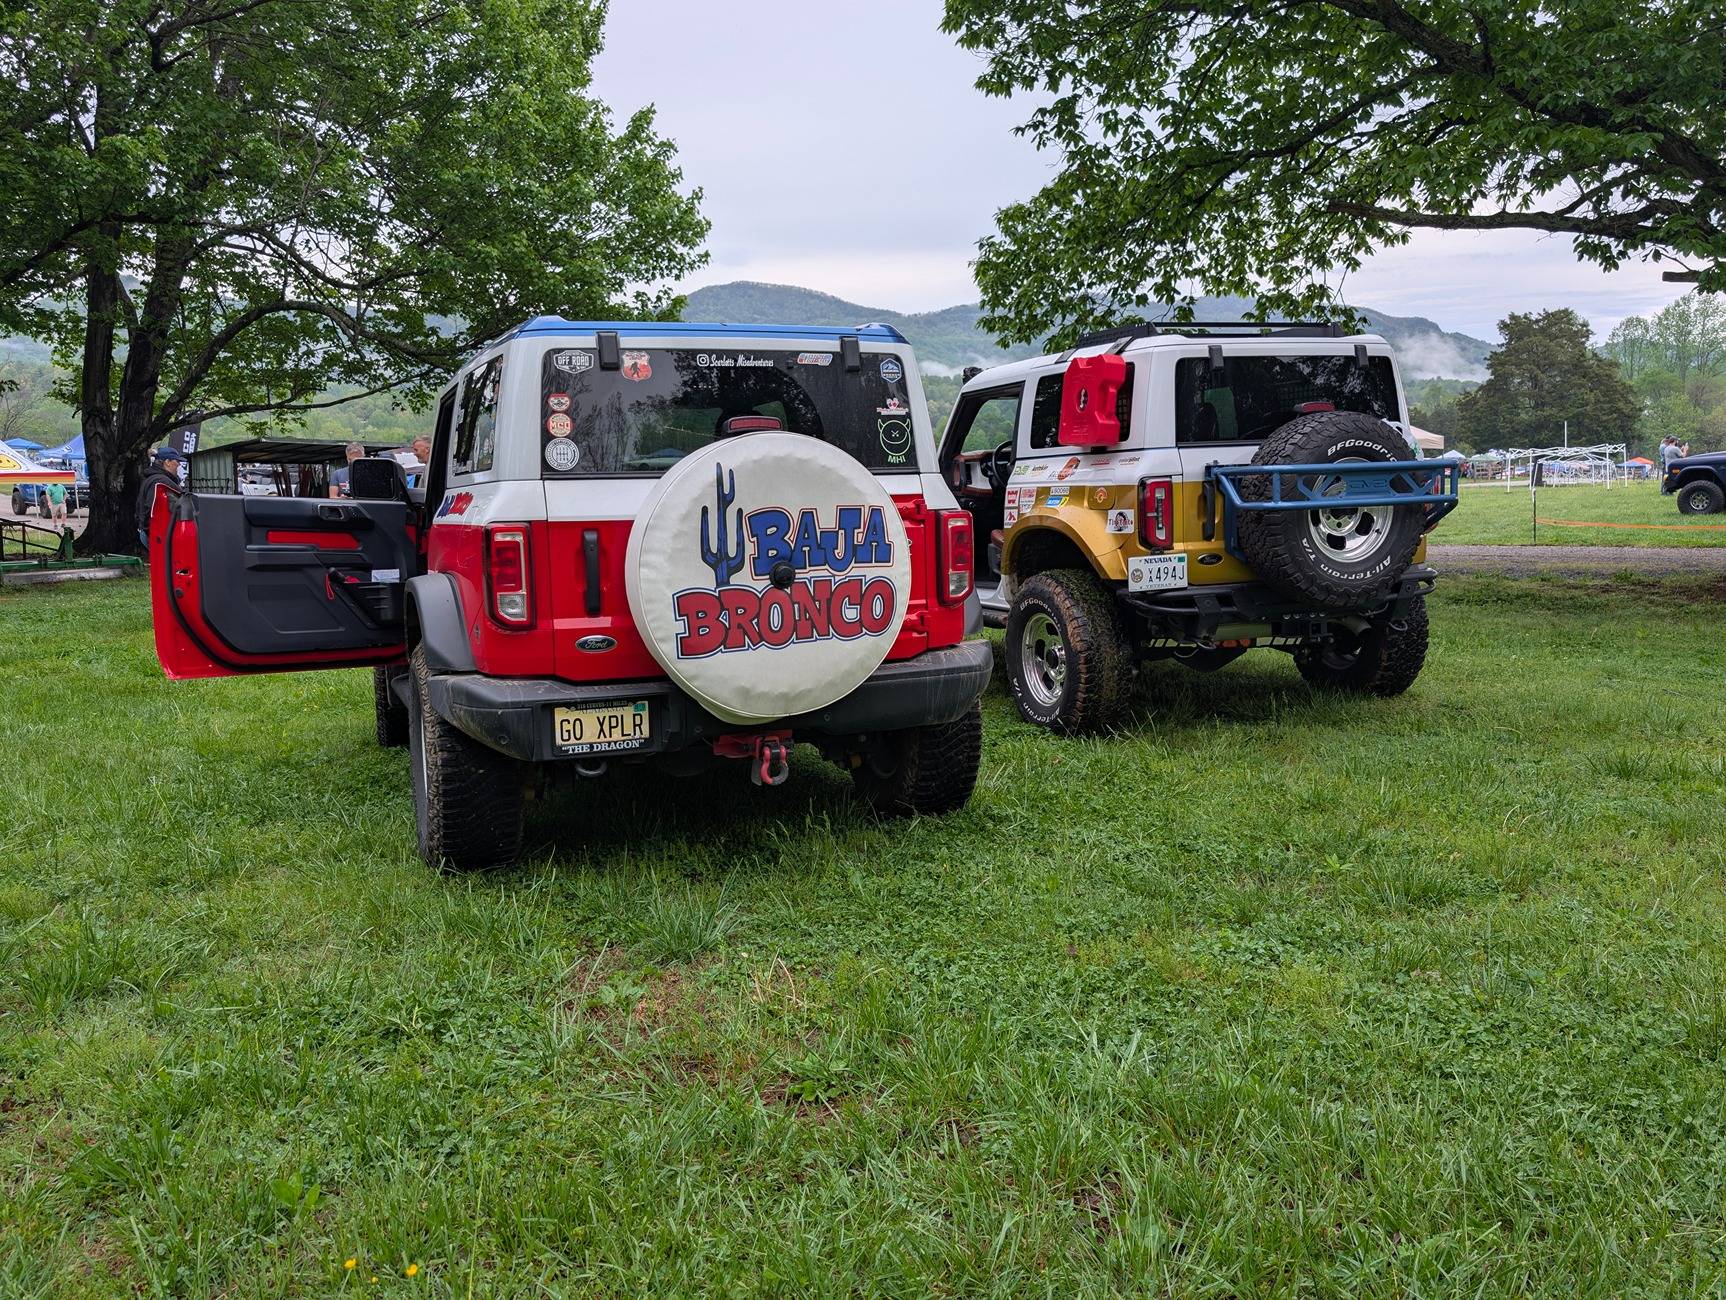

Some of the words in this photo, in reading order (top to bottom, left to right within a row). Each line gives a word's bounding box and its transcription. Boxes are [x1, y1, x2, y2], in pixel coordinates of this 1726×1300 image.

[557, 356, 569, 366] OFF
[571, 355, 590, 366] ROAD
[736, 354, 774, 367] Misadventures
[887, 455, 906, 464] MHI
[1327, 439, 1398, 463] BFGoodric
[744, 505, 895, 580] BAJA
[1144, 556, 1172, 565] NEVADA
[1319, 555, 1391, 580] All-Terrain
[672, 574, 898, 660] BRONCO
[584, 638, 608, 649] Ford
[559, 717, 584, 742] GO
[596, 713, 644, 739] XPLR
